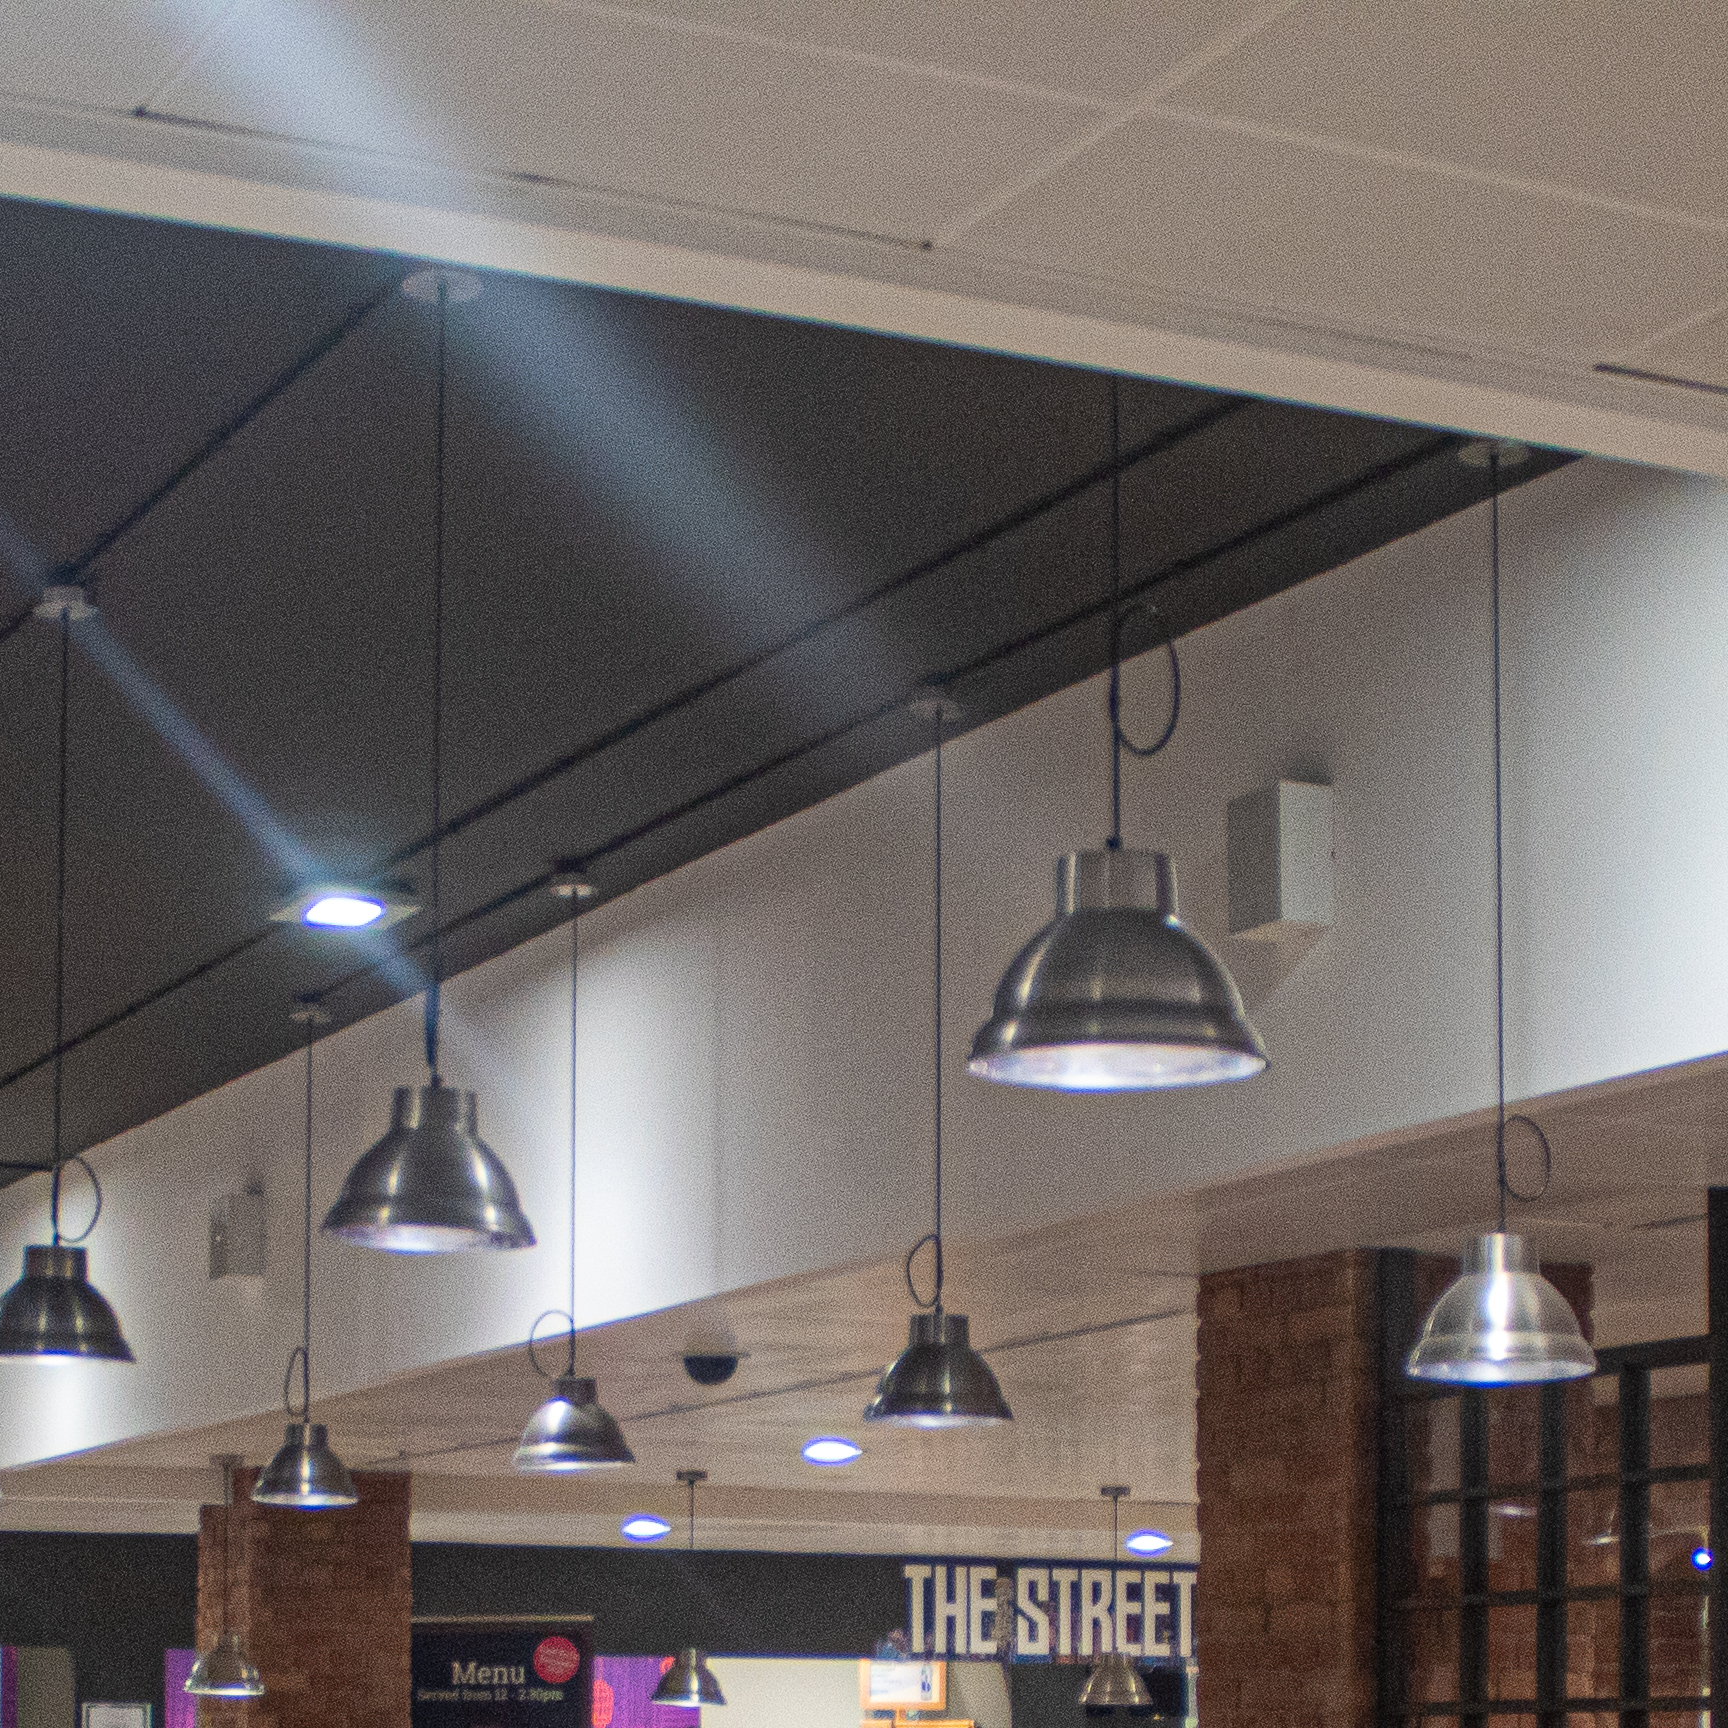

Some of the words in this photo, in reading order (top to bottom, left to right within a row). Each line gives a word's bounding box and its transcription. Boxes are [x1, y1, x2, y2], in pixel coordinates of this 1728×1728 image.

[904, 1564, 998, 1655] THE
[1016, 1567, 1198, 1657] STREET
[451, 1660, 525, 1685] Menu
